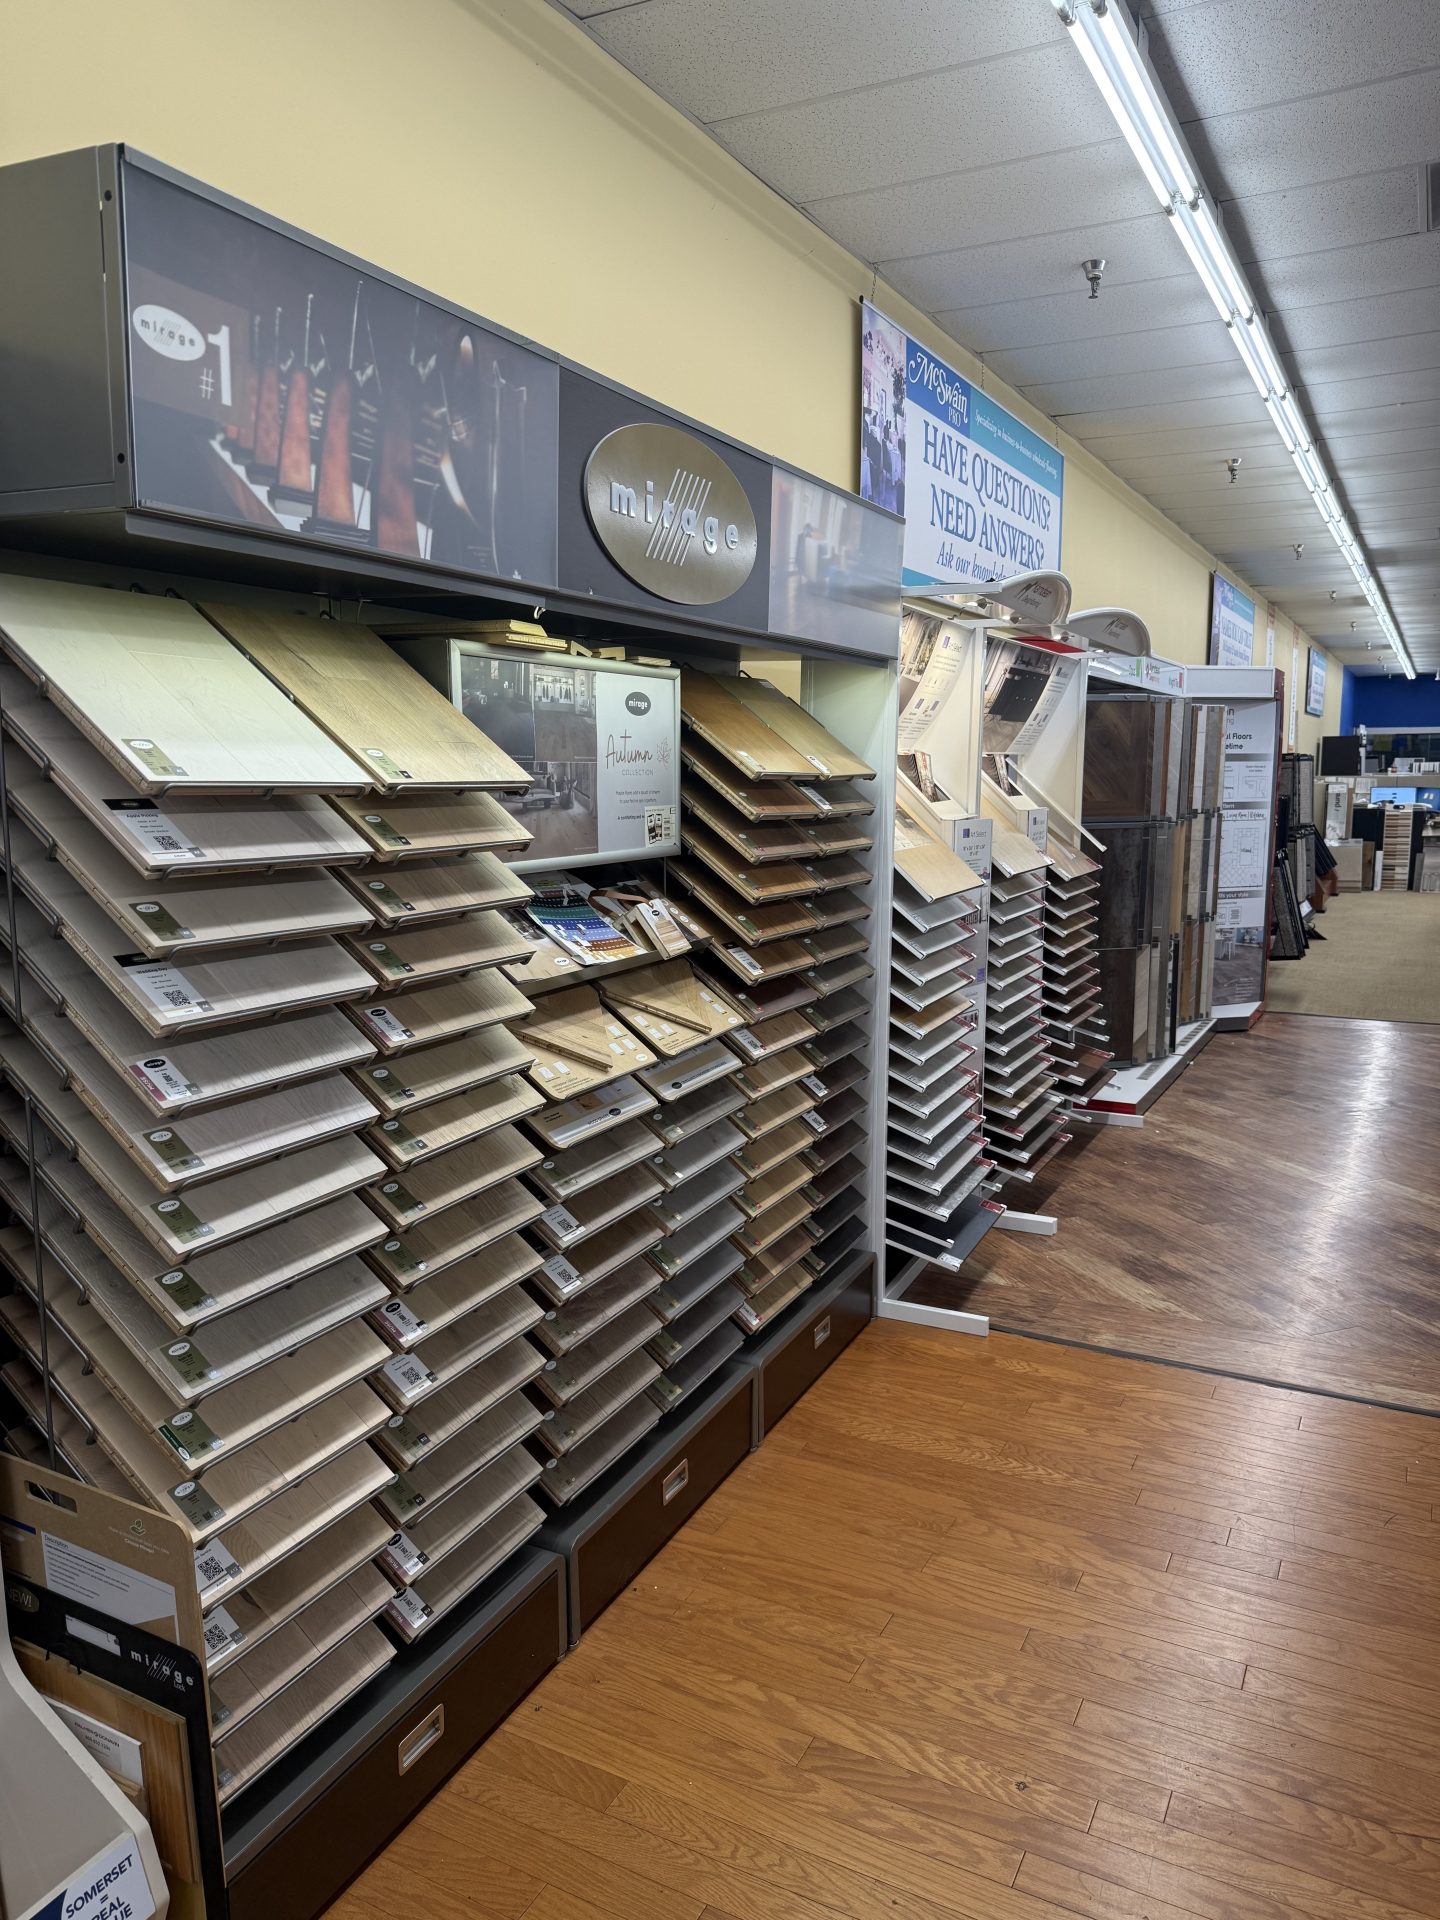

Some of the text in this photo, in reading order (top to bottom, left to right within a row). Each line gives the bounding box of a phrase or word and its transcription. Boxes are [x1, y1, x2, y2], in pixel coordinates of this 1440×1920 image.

[140, 318, 196, 347] mirage
[908, 352, 968, 424] McSwain
[948, 406, 961, 428] PRO
[923, 419, 1051, 532] HAVE QUESTIONS?
[610, 480, 740, 556] mirage
[930, 483, 1045, 571] NEED ANSWERS?
[936, 540, 953, 568] Ask
[955, 556, 971, 575] our
[628, 698, 648, 709] mirage
[605, 728, 653, 770] Autumn
[1232, 732, 1253, 741] Floors
[622, 768, 654, 776] COLLECTION
[44, 1534, 69, 1549] Description
[130, 1649, 195, 1686] mirage
[173, 1680, 186, 1692] Lock
[65, 1853, 133, 1919] SOMERSET
